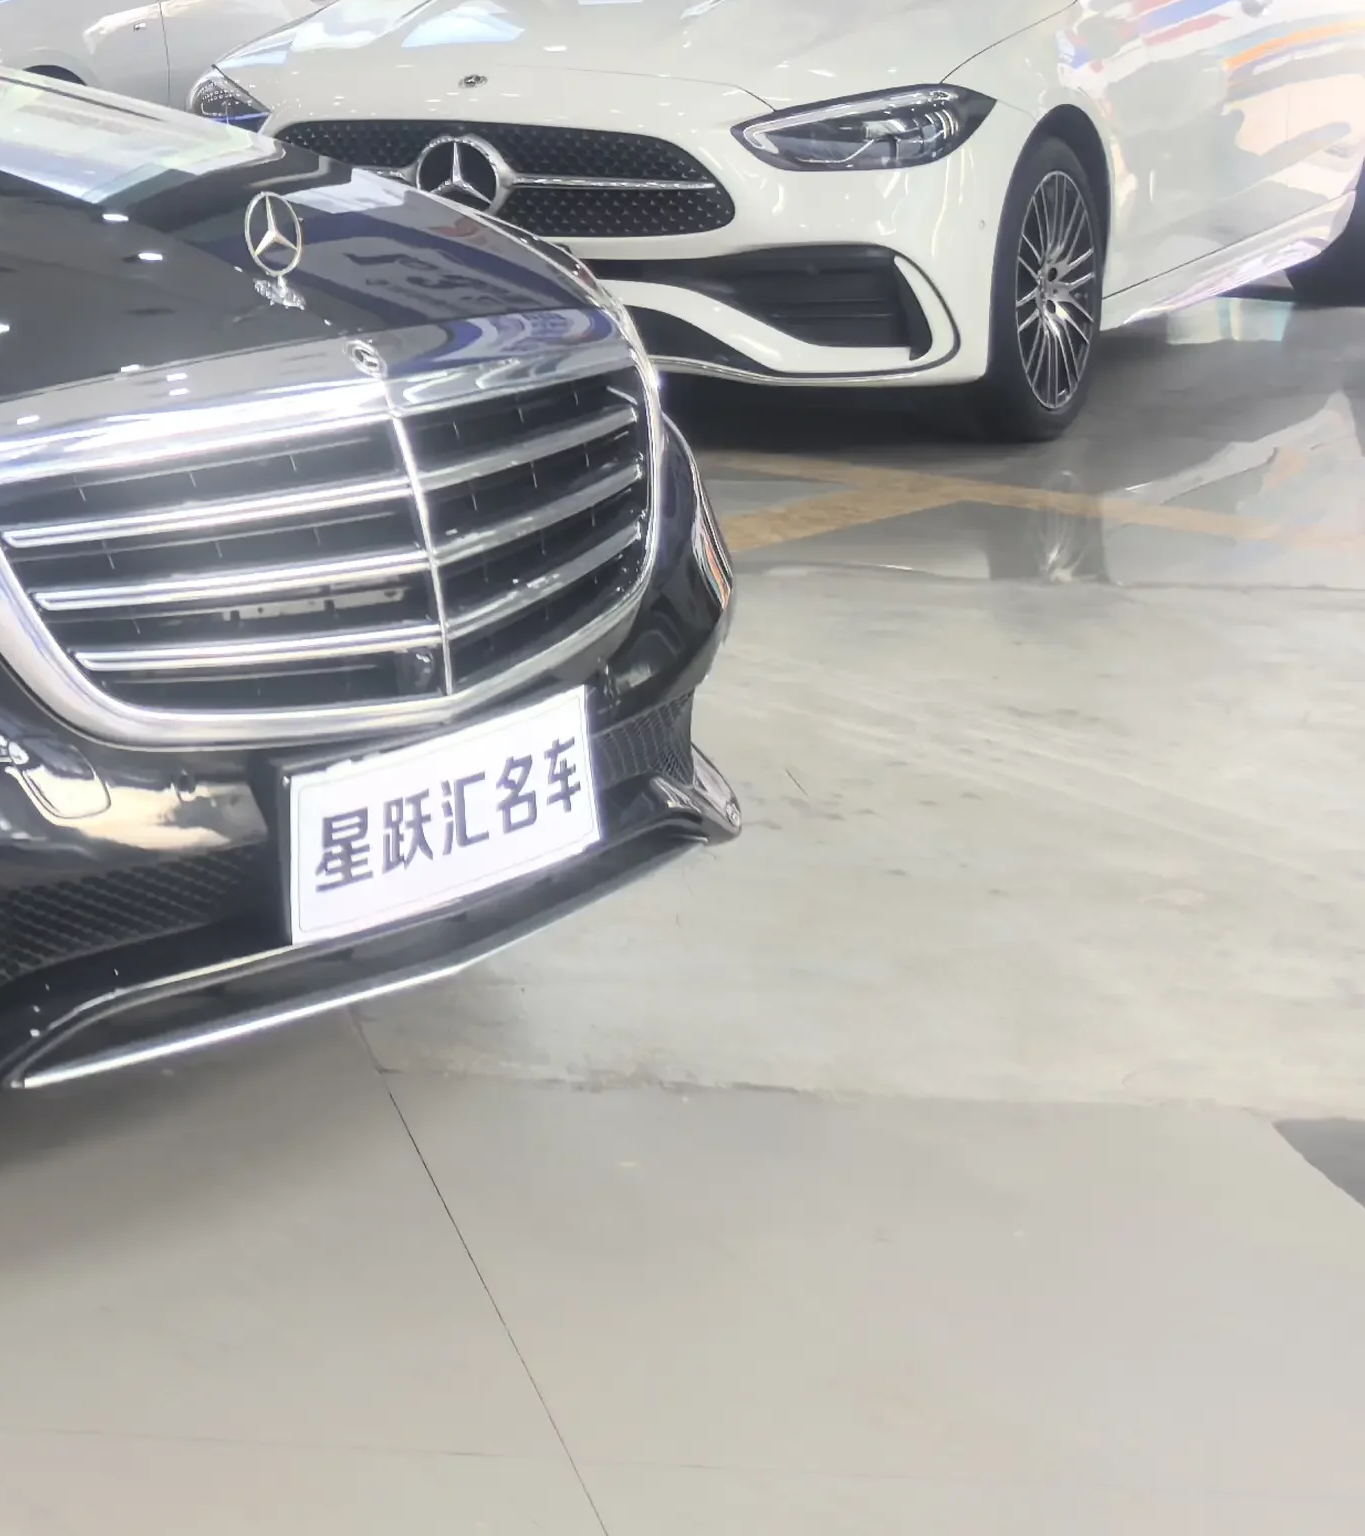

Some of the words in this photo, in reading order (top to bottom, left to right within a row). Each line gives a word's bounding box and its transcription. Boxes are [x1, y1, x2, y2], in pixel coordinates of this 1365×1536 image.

[316, 736, 581, 893] 星跃汇名车
